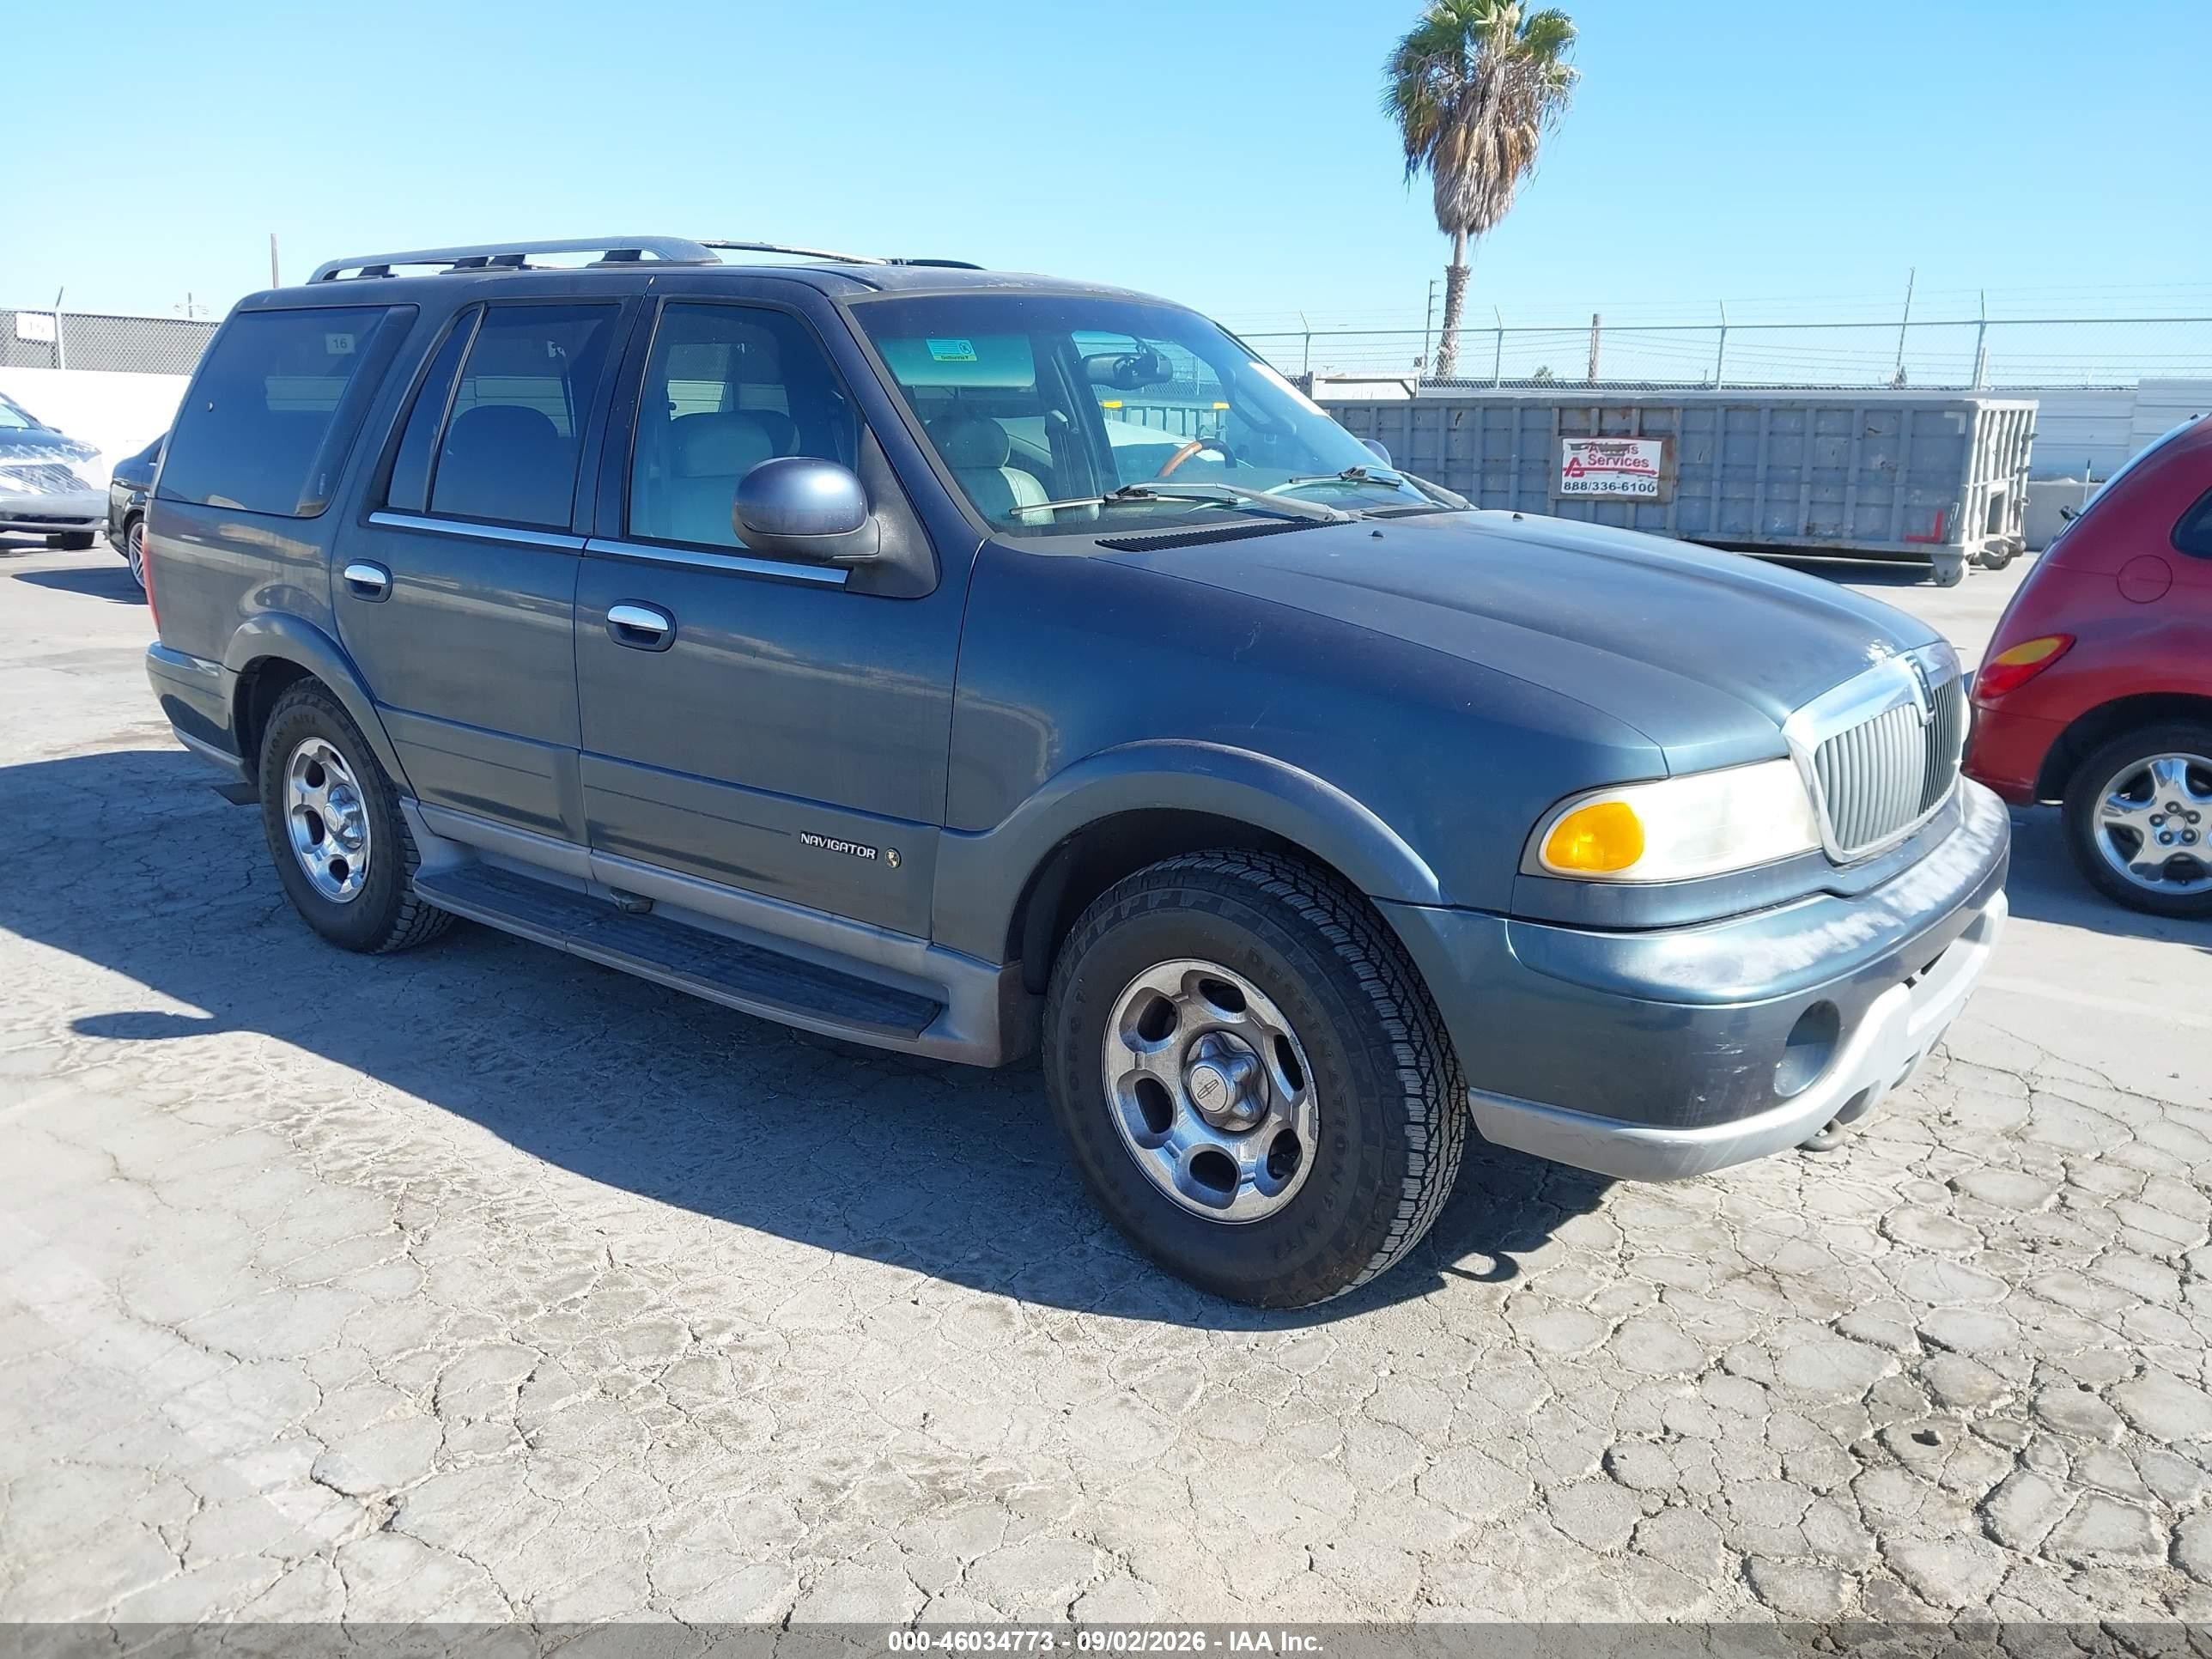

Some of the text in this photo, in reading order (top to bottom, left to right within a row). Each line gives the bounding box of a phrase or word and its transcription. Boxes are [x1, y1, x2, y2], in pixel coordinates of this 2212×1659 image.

[333, 338, 348, 349] 16
[1588, 455, 1649, 468] Services
[1564, 482, 1656, 493] 888/336-6100
[800, 832, 877, 860] NAVIGATOR
